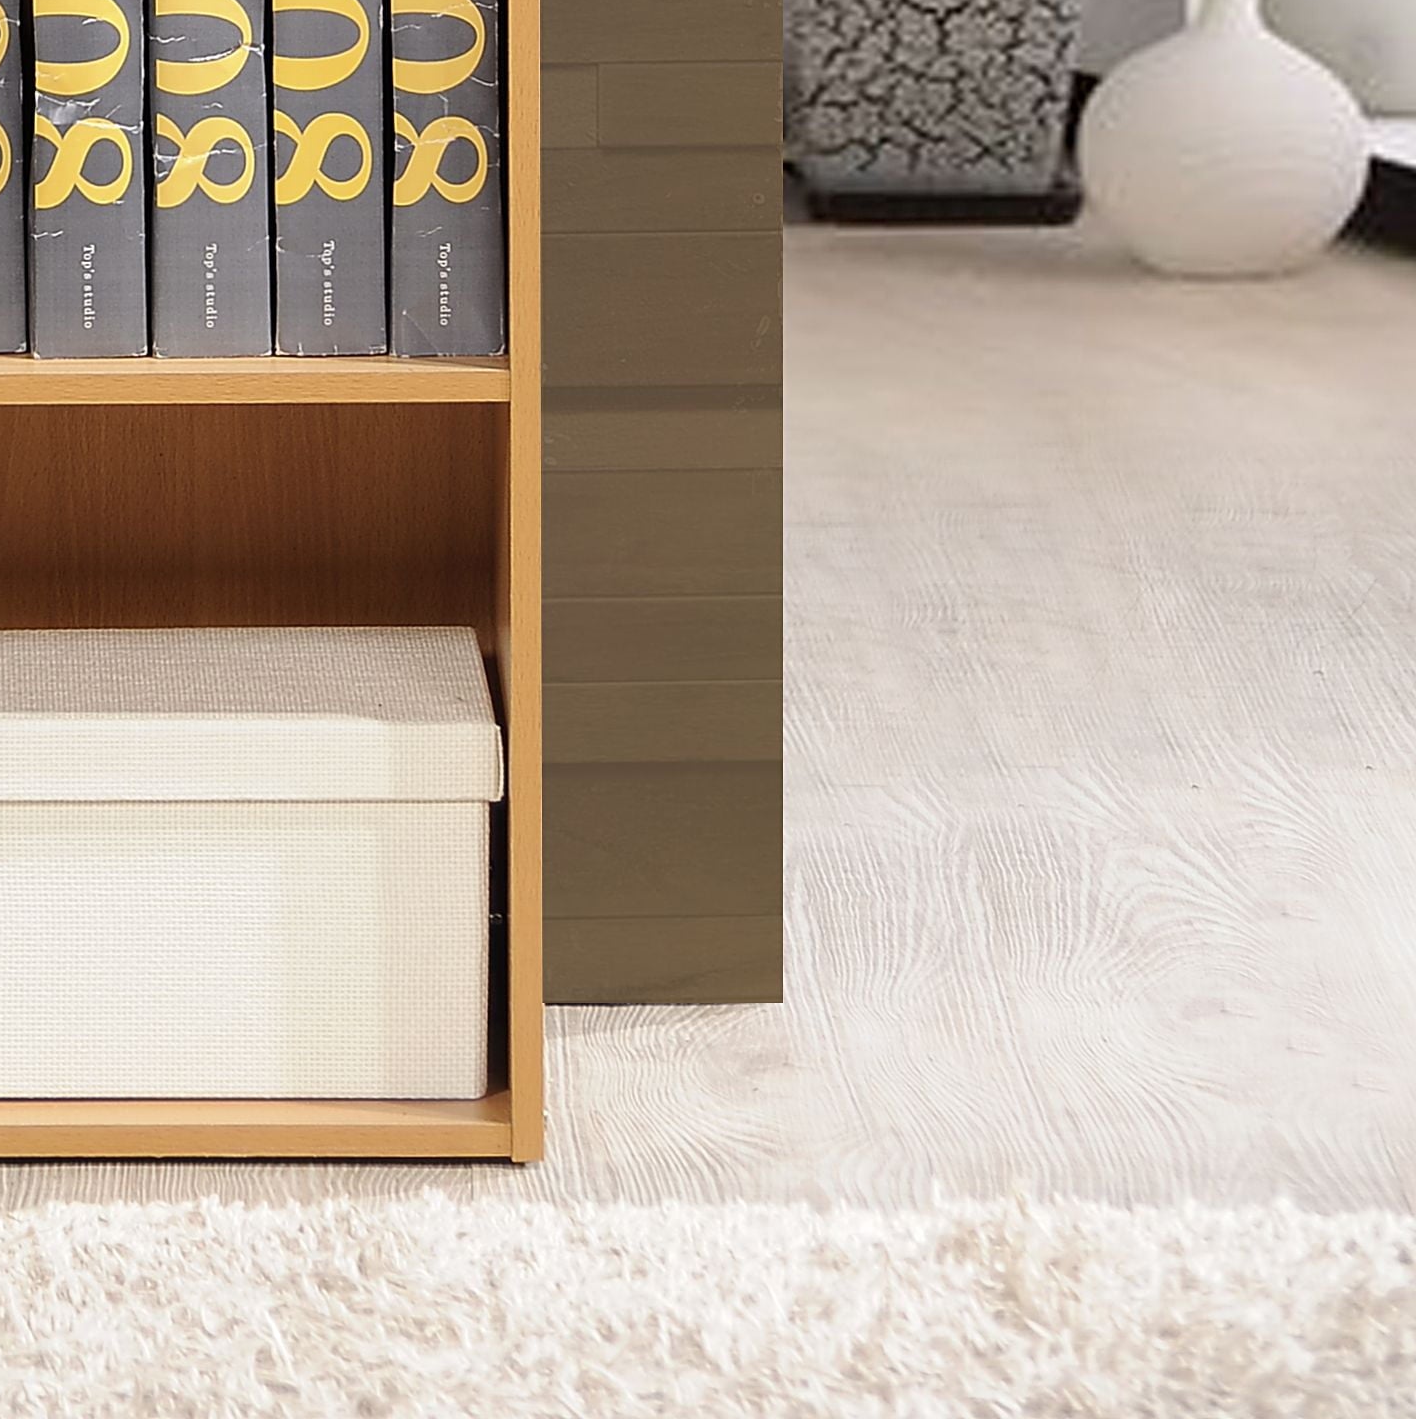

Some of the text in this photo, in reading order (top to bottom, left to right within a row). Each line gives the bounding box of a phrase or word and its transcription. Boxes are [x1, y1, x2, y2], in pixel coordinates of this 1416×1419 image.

[80, 244, 96, 329] Top's studio
[202, 242, 219, 329] Top's studio
[319, 239, 336, 326] Top's studio
[436, 242, 452, 326] Top's studio
